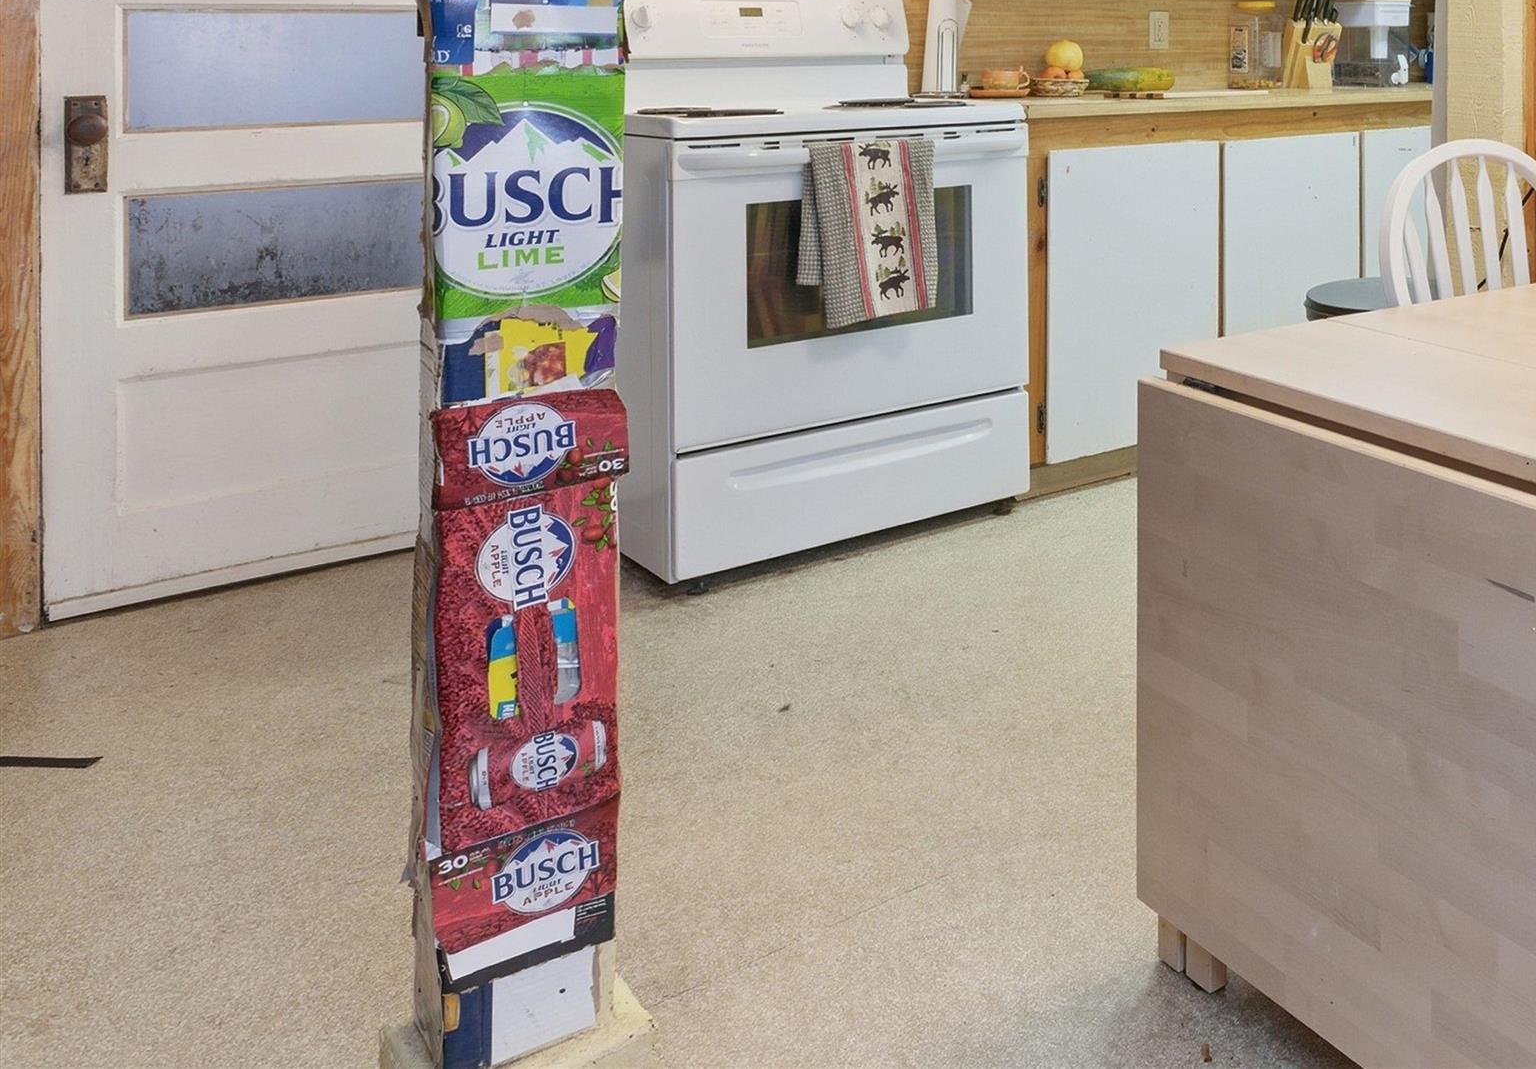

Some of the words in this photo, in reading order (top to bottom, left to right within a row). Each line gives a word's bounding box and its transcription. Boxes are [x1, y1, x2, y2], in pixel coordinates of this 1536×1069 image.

[484, 229, 560, 248] LIGHT
[477, 246, 565, 270] LIME
[494, 411, 546, 429] APPLE
[471, 421, 574, 465] BUSCH
[598, 457, 625, 472] 30
[490, 544, 501, 588] APPLE
[509, 508, 546, 607] BUSCH
[533, 731, 557, 790] BUSCH
[438, 853, 469, 874] 30
[493, 842, 597, 902] BUSCH
[522, 881, 574, 906] APPLE
